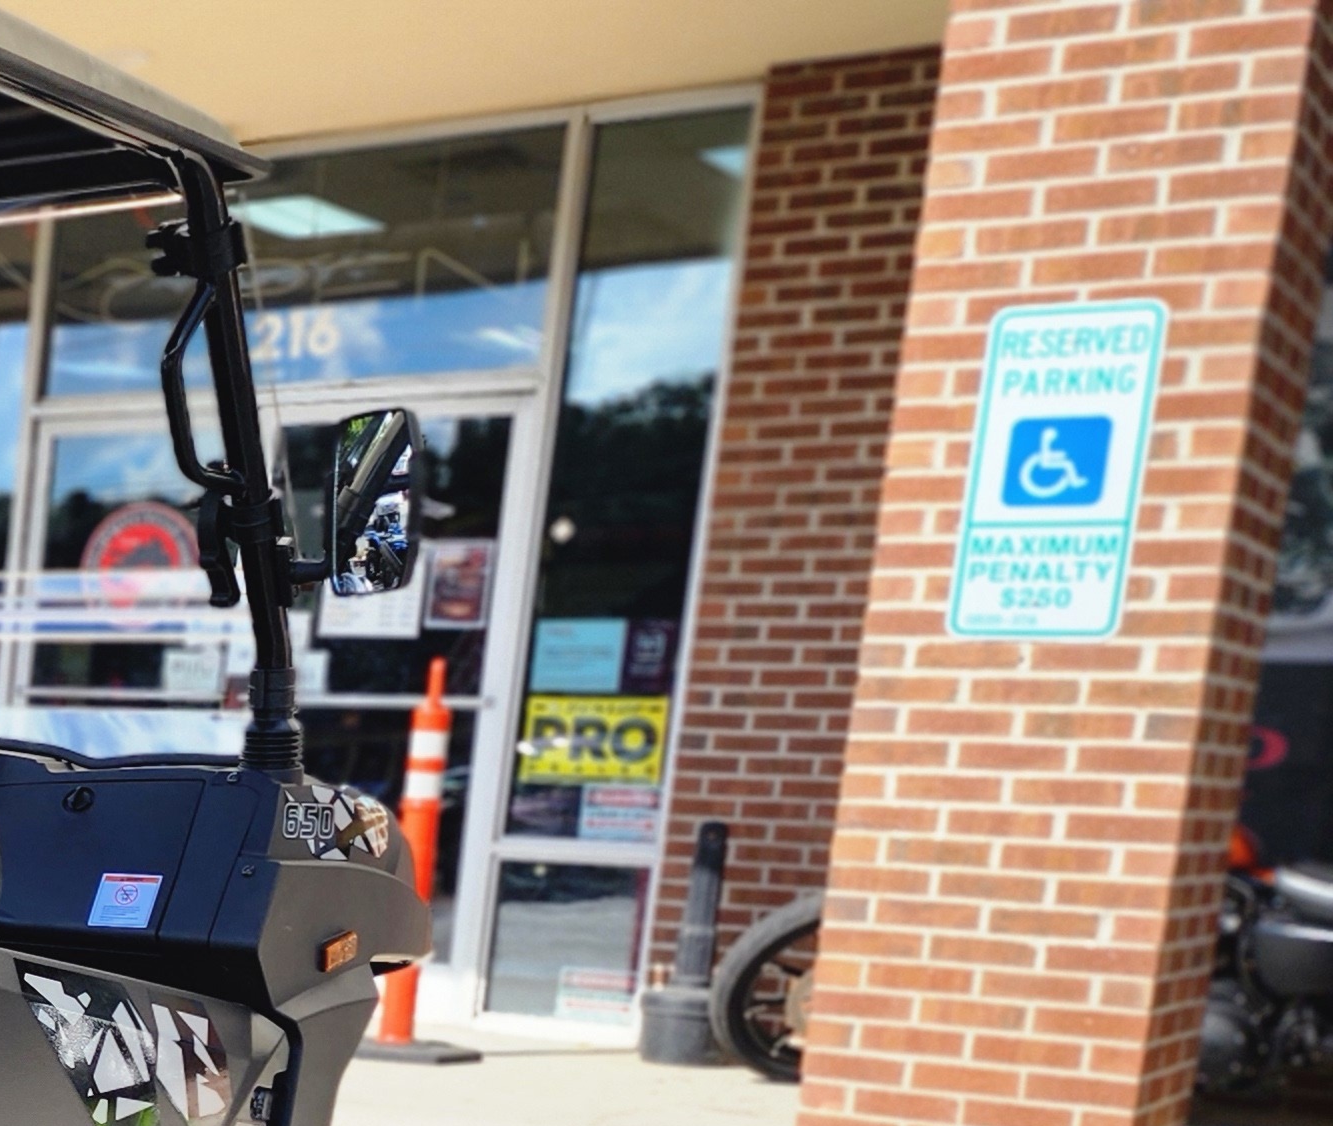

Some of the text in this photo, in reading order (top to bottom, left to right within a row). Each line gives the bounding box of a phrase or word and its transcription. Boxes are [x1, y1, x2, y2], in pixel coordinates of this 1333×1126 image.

[249, 308, 341, 362] 216
[1001, 322, 1152, 360] RESERVED
[1001, 362, 1137, 397] PARKING
[970, 534, 1120, 557] MAXIMUM
[967, 560, 1113, 582] PENALTY
[999, 586, 1073, 609] $250
[529, 716, 658, 764] PRO
[282, 802, 335, 840] 650
